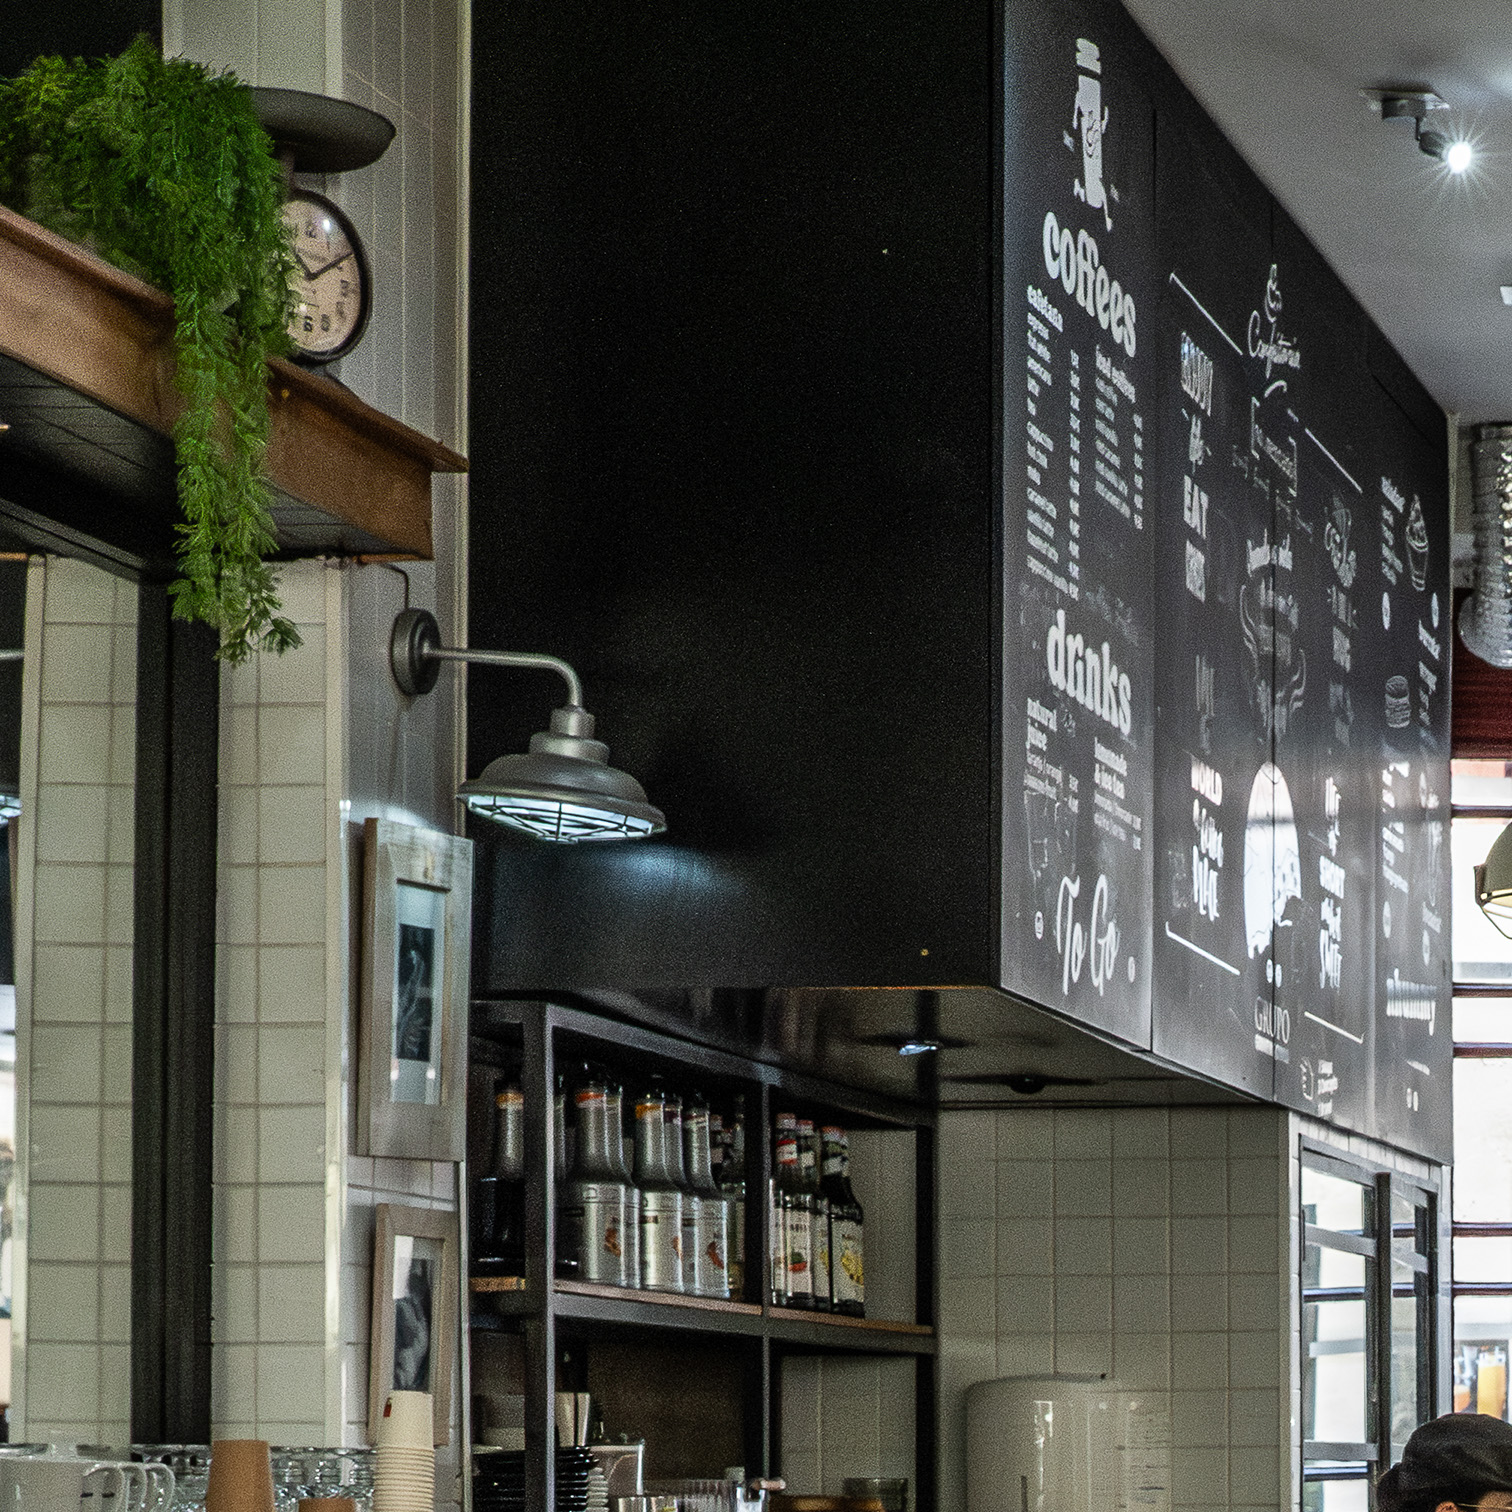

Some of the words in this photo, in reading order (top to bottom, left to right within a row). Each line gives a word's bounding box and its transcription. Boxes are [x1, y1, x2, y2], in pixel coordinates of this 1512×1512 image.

[1183, 474, 1209, 540] EAT
[1047, 609, 1131, 735] drinks
[1191, 754, 1223, 806] WORLD
[1055, 876, 1088, 995] To
[1090, 874, 1120, 996] Go
[1254, 996, 1290, 1044] GRUPO
